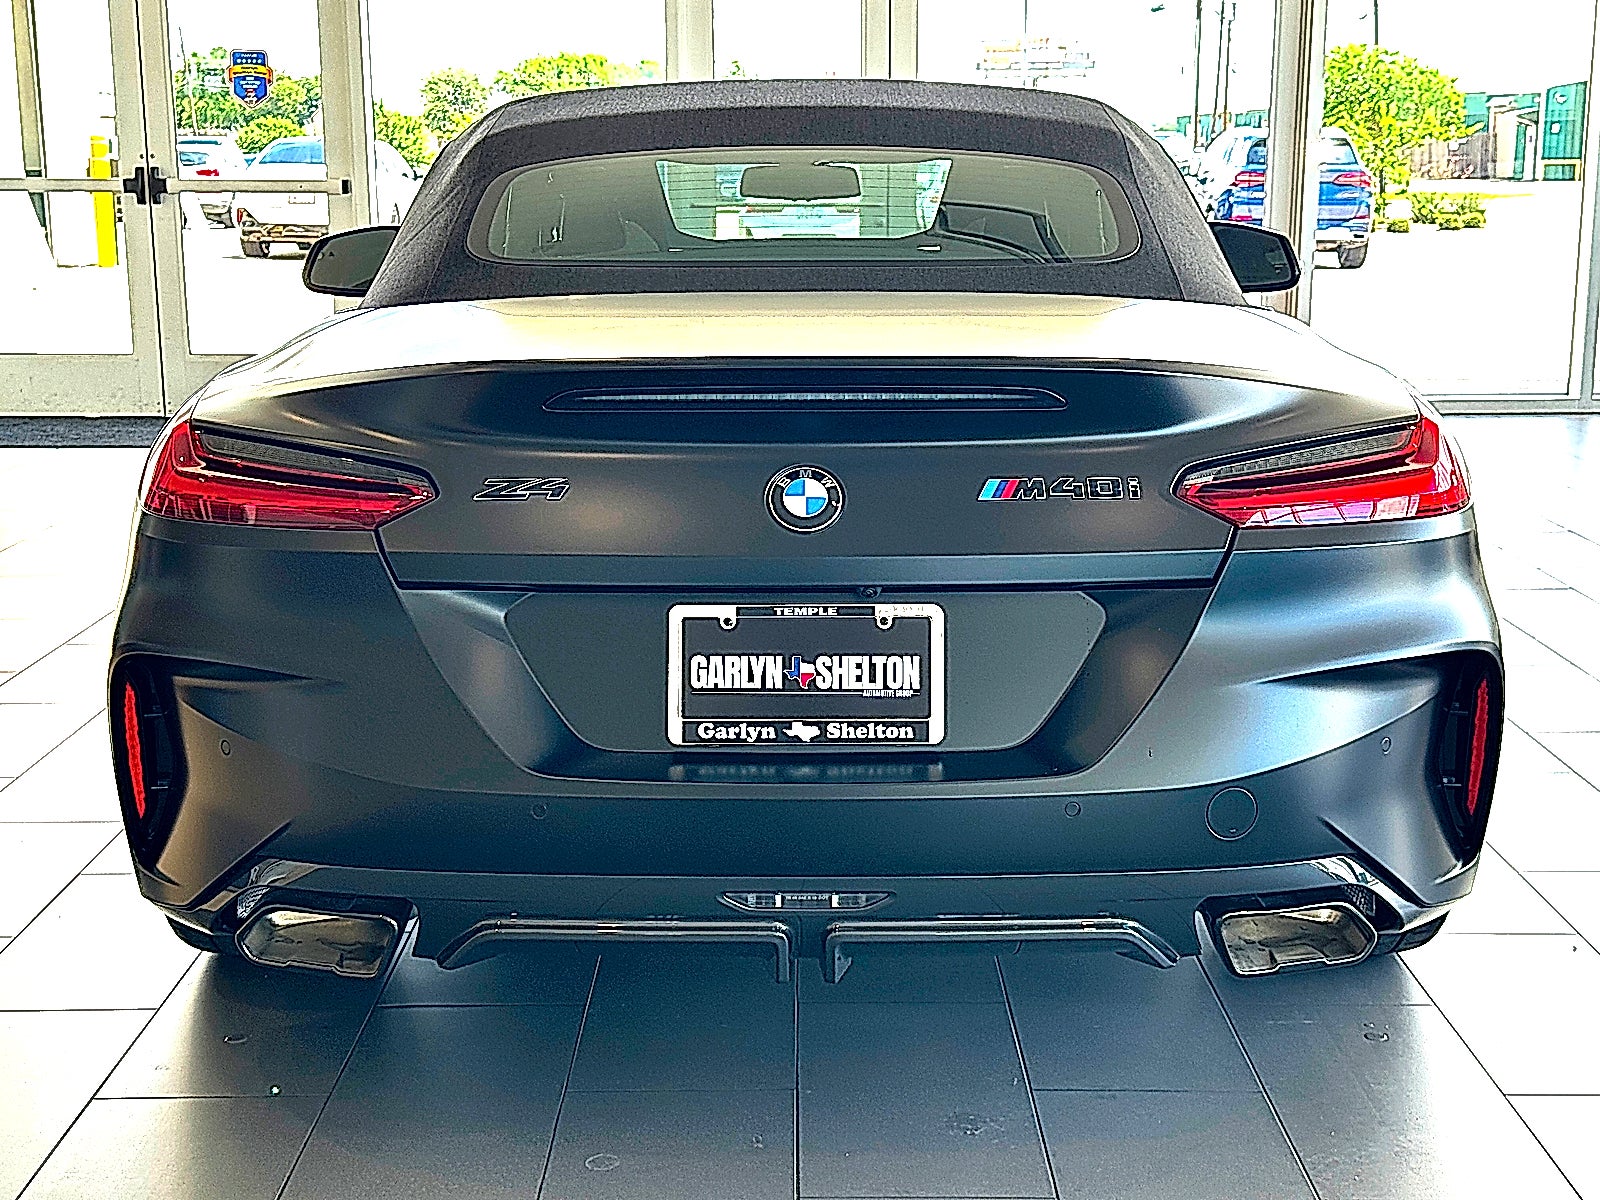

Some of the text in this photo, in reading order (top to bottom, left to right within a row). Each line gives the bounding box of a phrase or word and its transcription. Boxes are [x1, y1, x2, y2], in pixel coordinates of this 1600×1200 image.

[473, 476, 570, 502] Z4
[777, 469, 836, 489] BMW
[1014, 477, 1142, 500] M40i
[773, 606, 838, 617] TEMPLE
[690, 655, 921, 690] GARLYN SHELTON
[697, 722, 915, 743] Garlyn Shelton
